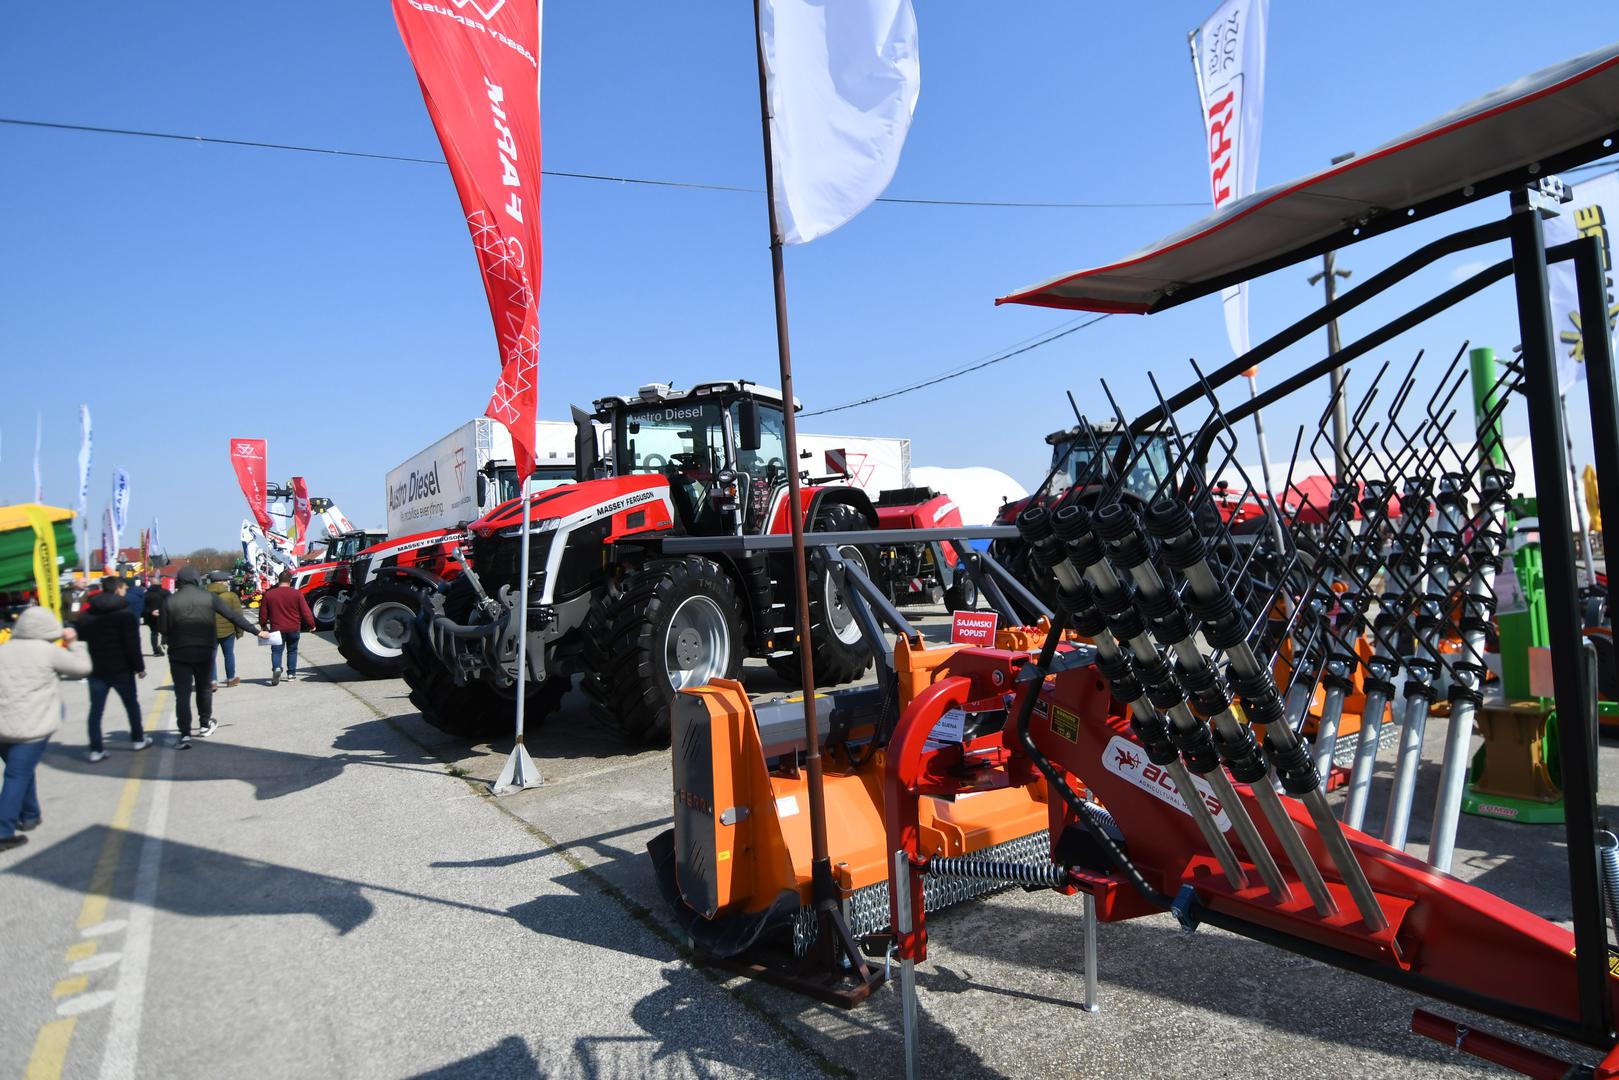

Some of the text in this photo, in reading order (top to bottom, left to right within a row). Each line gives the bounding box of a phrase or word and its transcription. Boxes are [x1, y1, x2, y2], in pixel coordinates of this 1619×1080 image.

[1223, 10, 1239, 70] 2024
[665, 405, 703, 420] Diesel
[408, 460, 441, 502] Diesel
[596, 491, 655, 516] MASSEY FERGUSON
[397, 541, 425, 552] MASSEY
[956, 618, 992, 628] SAJAMSKI
[959, 629, 987, 637] POPUST
[1138, 779, 1181, 807] AGRICULTURAL
